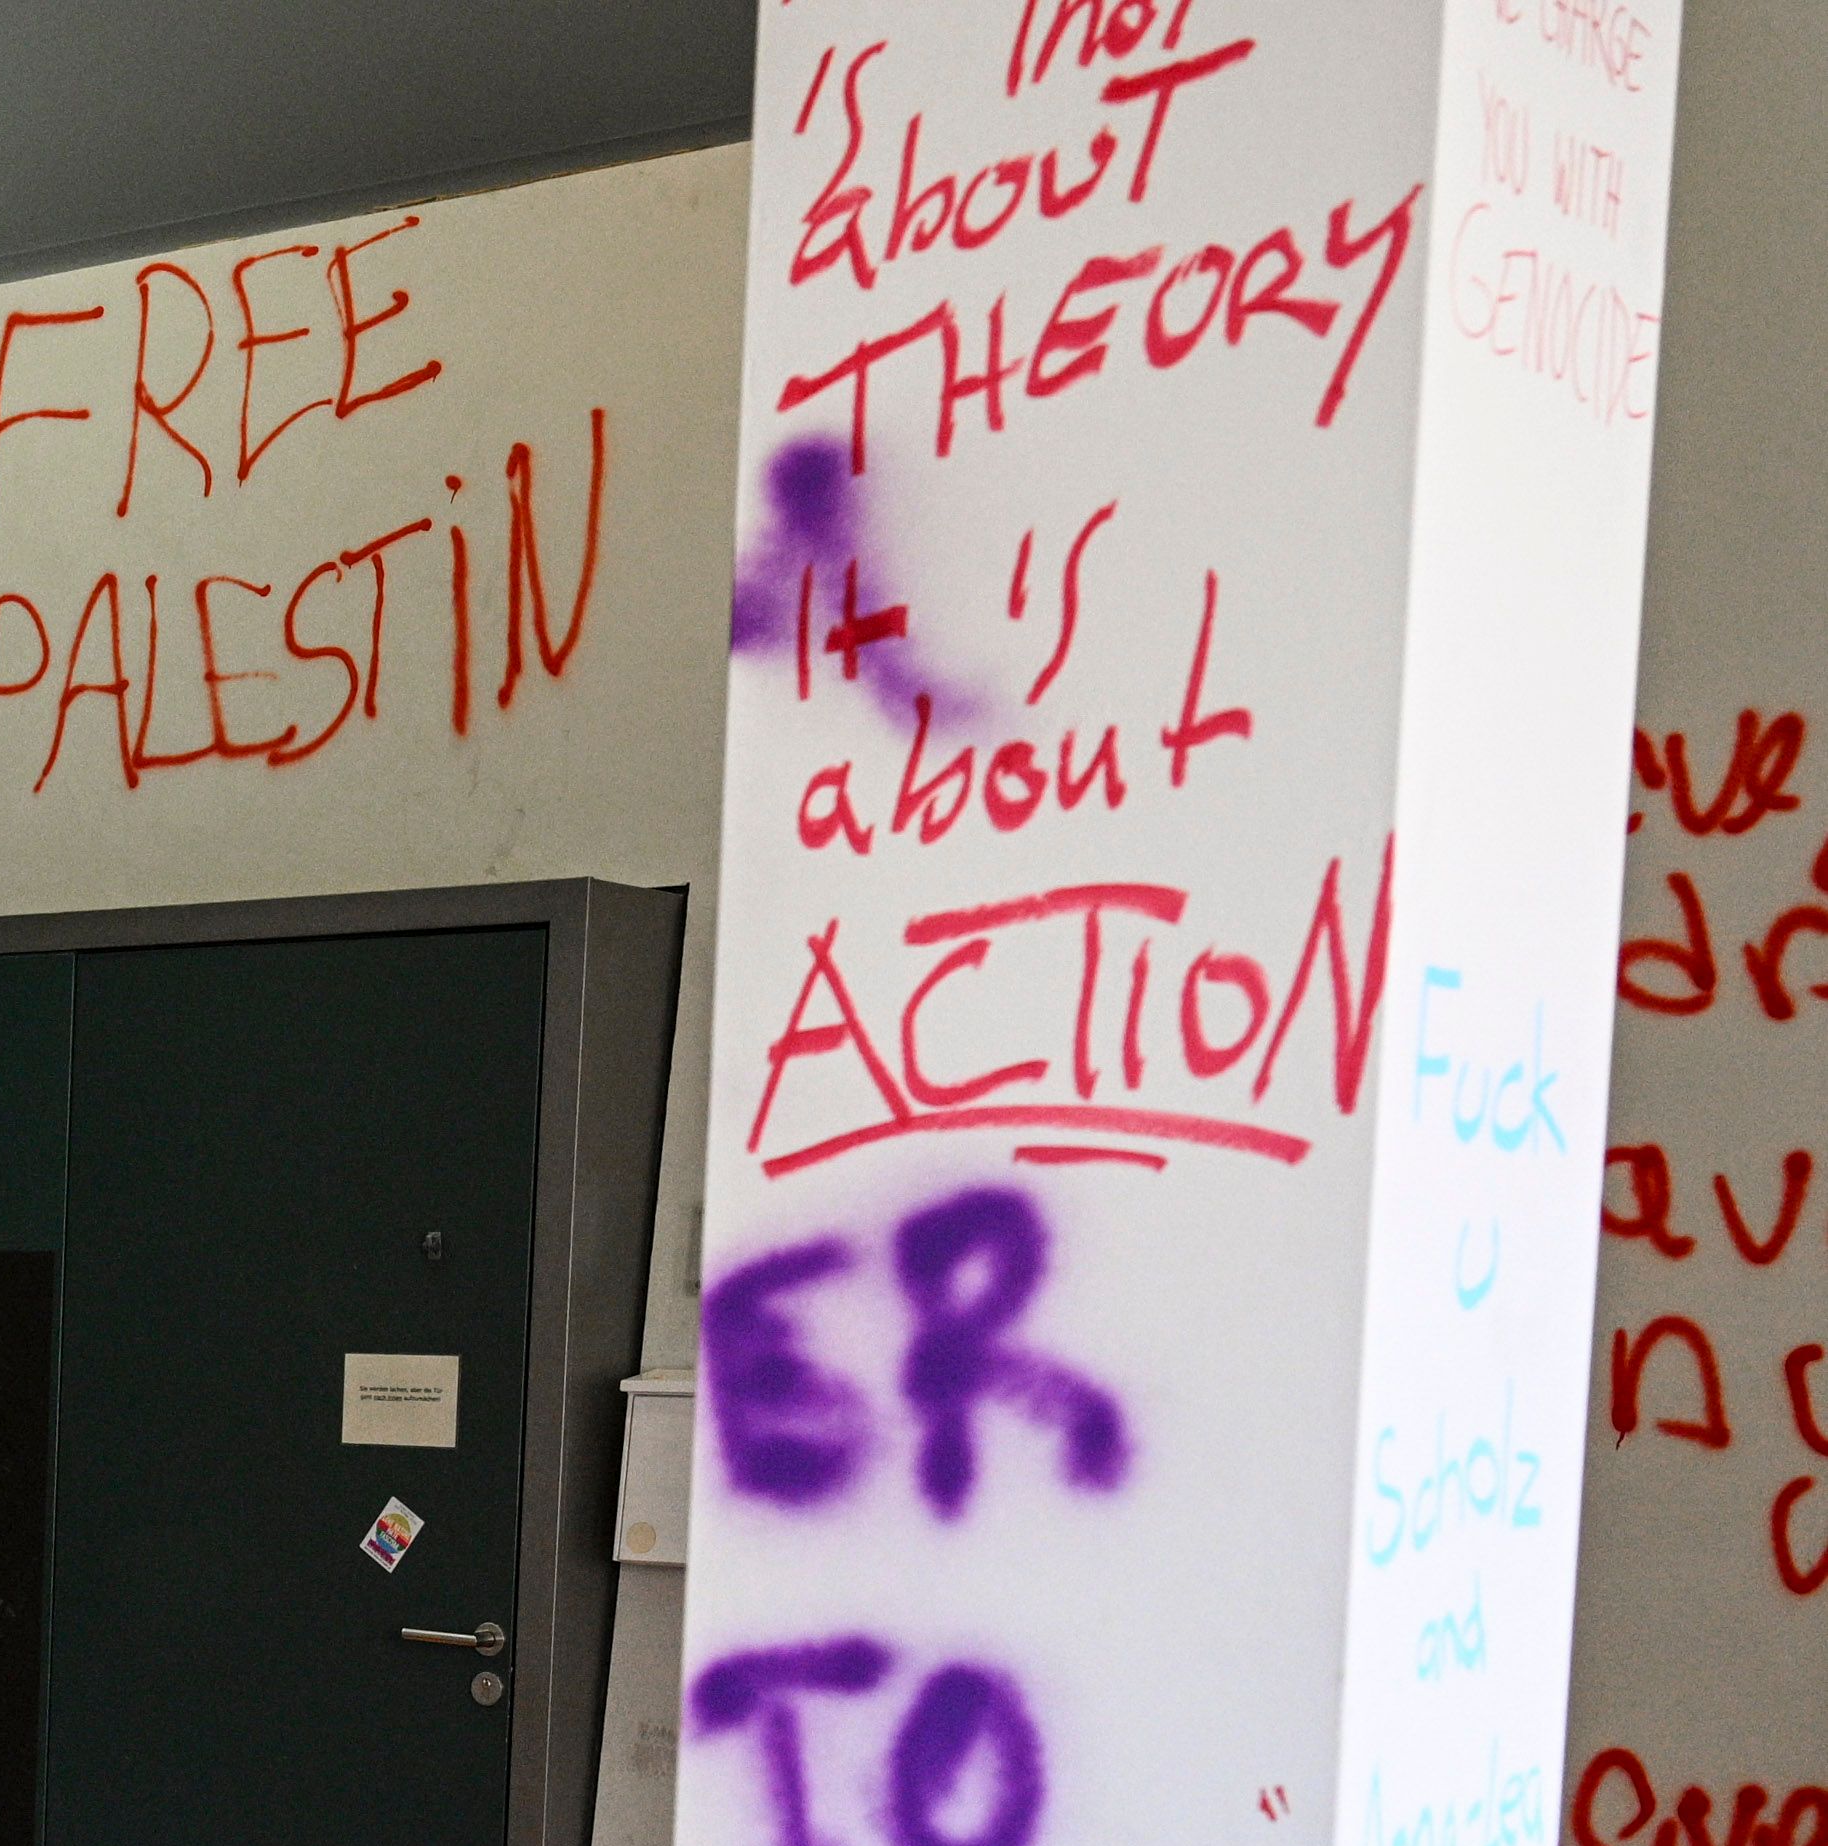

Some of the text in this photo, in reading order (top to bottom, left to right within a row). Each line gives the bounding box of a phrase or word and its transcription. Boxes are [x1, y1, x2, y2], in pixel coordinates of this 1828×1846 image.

[774, 180, 1425, 477] THEORY
[796, 568, 1252, 856] about
[747, 827, 1400, 1154] ACTION
[1409, 964, 1568, 1160] Fuck
[1364, 1376, 1543, 1569] Scholz
